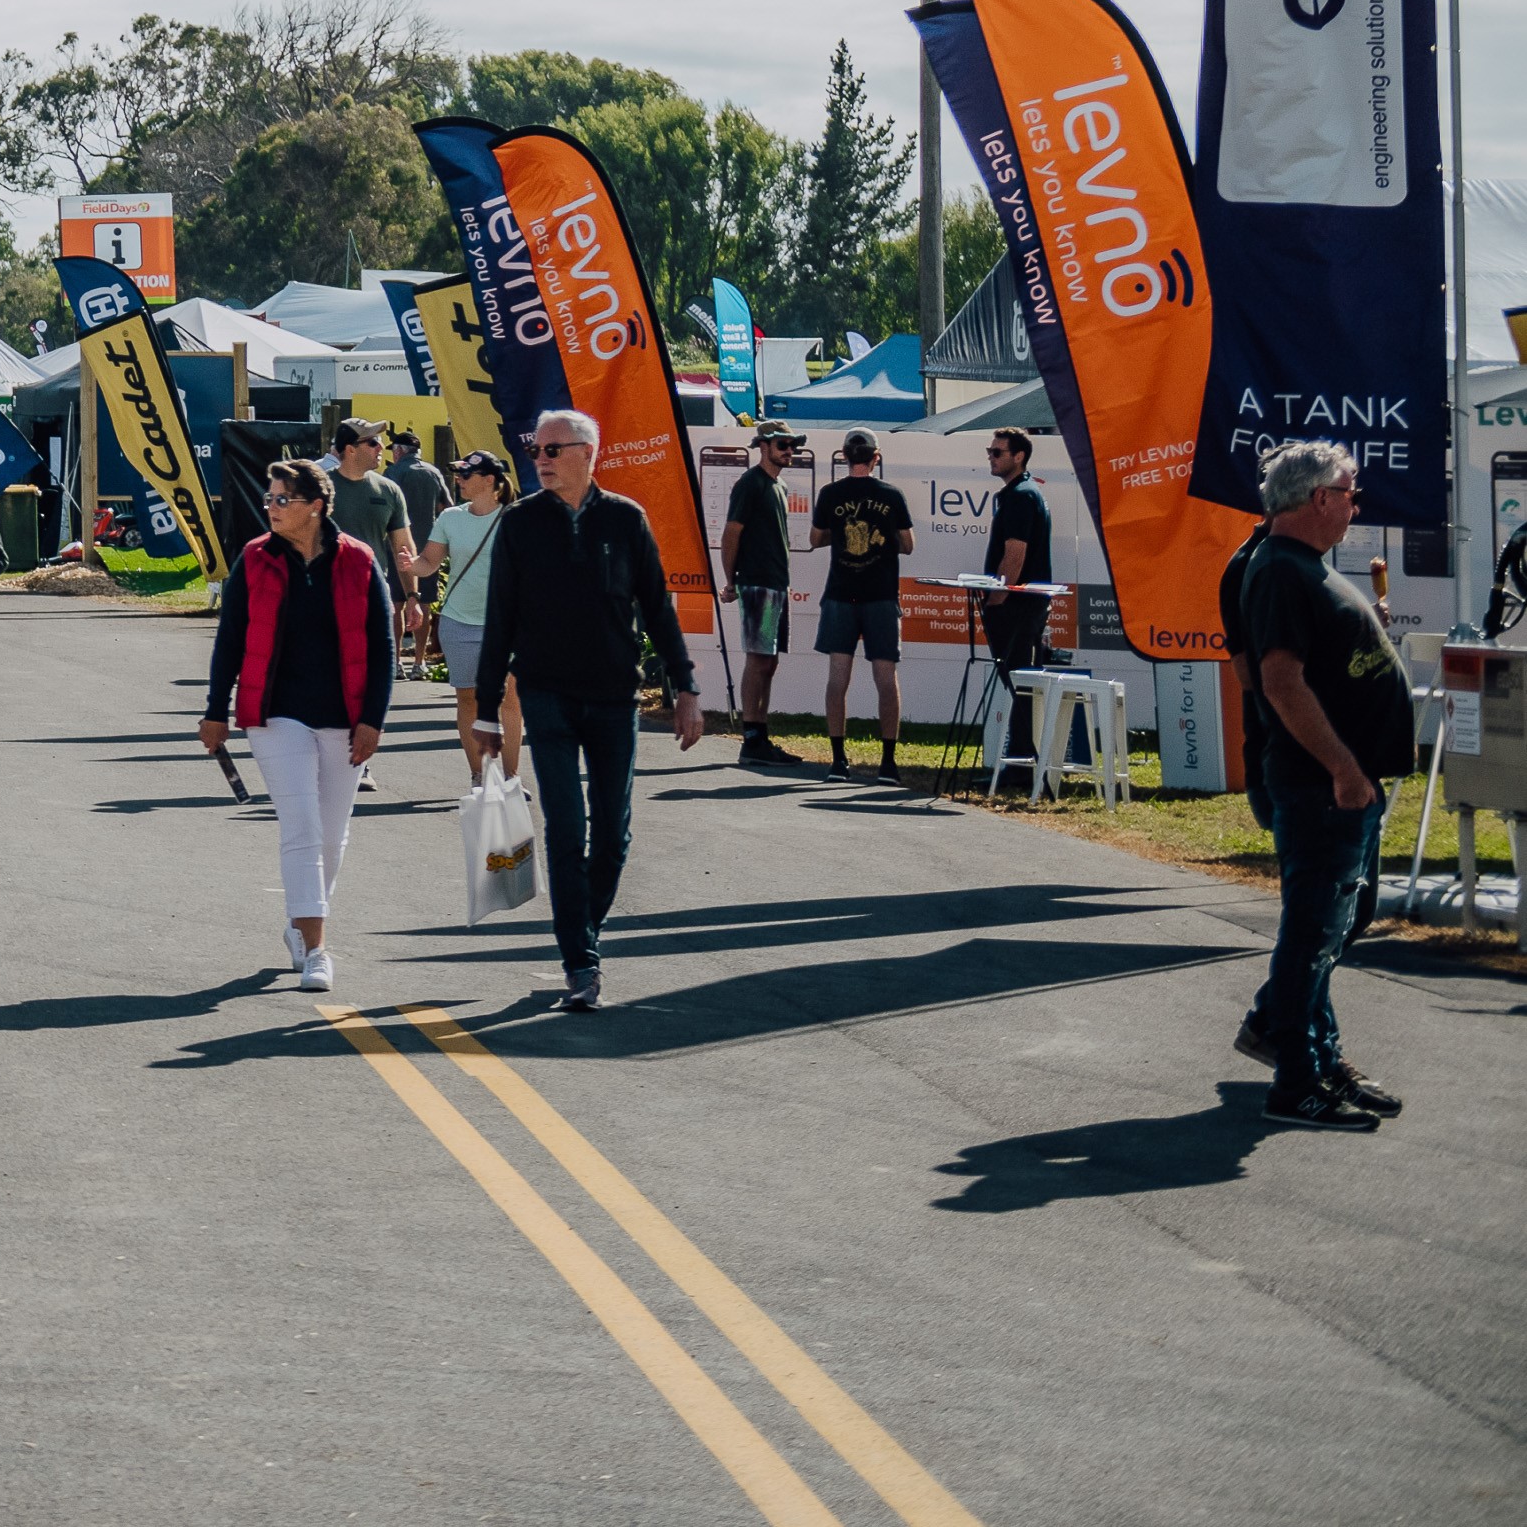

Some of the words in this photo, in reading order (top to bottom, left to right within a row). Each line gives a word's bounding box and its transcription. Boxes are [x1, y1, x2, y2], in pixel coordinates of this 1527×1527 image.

[1018, 98, 1052, 153] lets
[1366, 75, 1391, 190] engineering
[1032, 159, 1066, 214] you
[1053, 73, 1162, 317] levno
[460, 207, 481, 242] lets
[529, 217, 551, 255] lets
[979, 129, 1018, 184] lets
[1001, 188, 1033, 242] you
[1023, 247, 1057, 324] know
[468, 246, 490, 282] you
[537, 258, 564, 295] you
[552, 192, 627, 361] levno
[1054, 222, 1088, 302] know
[481, 288, 506, 339] know
[555, 300, 581, 354] know
[343, 364, 360, 372] Car
[373, 363, 409, 372] Comme
[102, 338, 182, 482] Cadet
[1239, 387, 1265, 419] A
[1273, 393, 1410, 430] TANK
[607, 439, 648, 455] LEVNO
[648, 433, 671, 449] FOR
[626, 449, 667, 466] TODAY!
[1109, 453, 1136, 471] TRY
[1139, 440, 1195, 465] LEVNO
[1351, 441, 1410, 470] IFE
[1121, 470, 1163, 490] FREE
[834, 502, 857, 517] ON
[866, 499, 891, 517] THE
[930, 479, 995, 518] lev
[930, 522, 959, 534] lets
[961, 524, 988, 537] you
[901, 592, 950, 604] monitors
[914, 606, 941, 618] time,
[943, 606, 965, 617] and
[1089, 597, 1115, 608] Levn
[1089, 612, 1103, 621] on
[1106, 612, 1119, 623] yo
[1390, 614, 1422, 626] vno
[1148, 625, 1227, 650] levno
[1179, 661, 1193, 683] fu
[1180, 687, 1193, 715] for
[1183, 718, 1198, 771] levno
